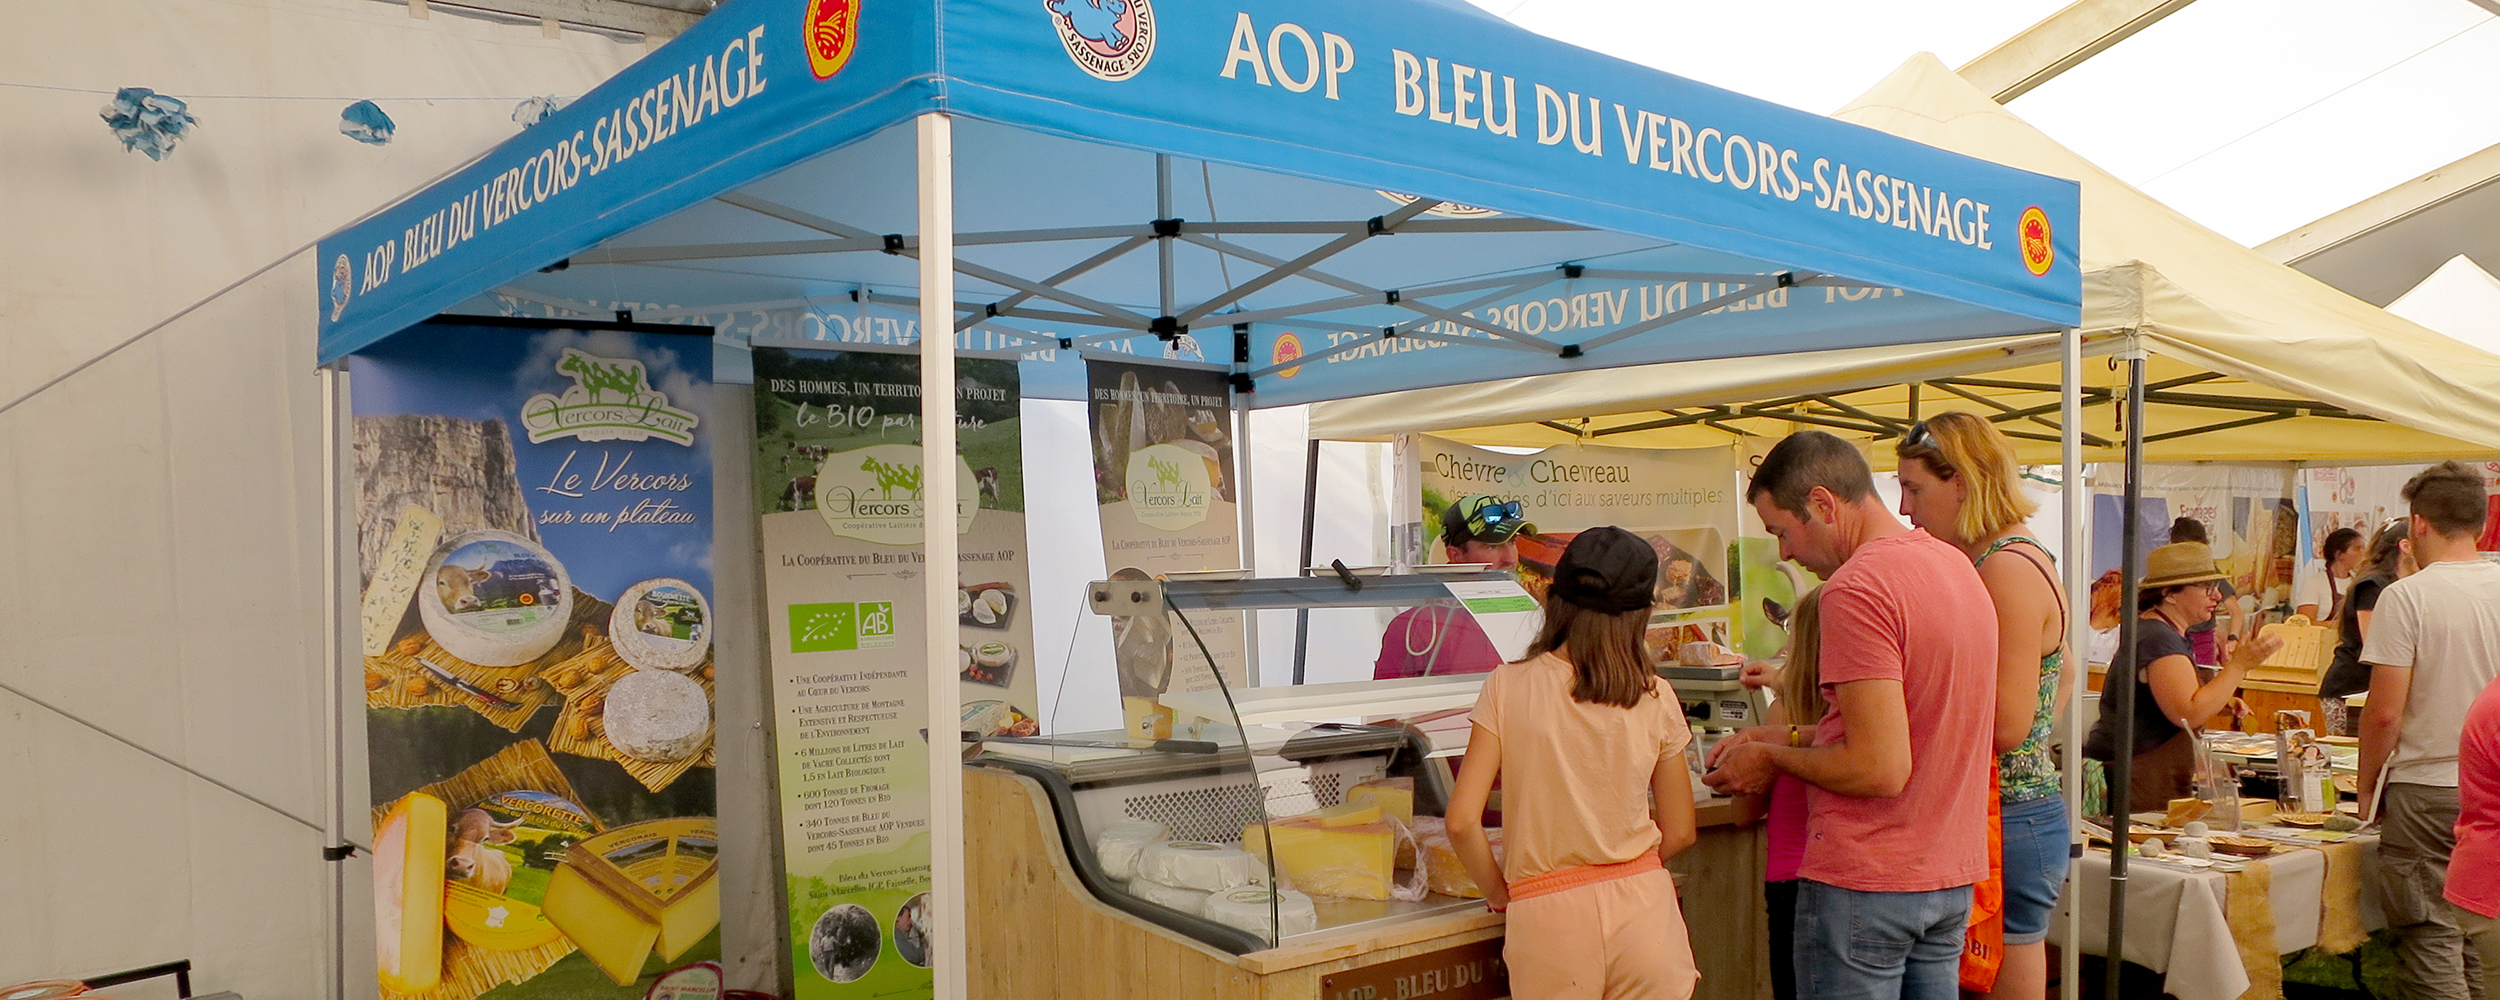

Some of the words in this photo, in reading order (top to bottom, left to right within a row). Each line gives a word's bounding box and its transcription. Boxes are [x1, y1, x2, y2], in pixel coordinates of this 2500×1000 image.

[1127, 12, 1149, 65] VERCORS
[1068, 32, 1126, 73] SASSENAGE
[1220, 12, 1355, 100] AOP
[1392, 48, 1518, 138] BLEU
[1535, 83, 1602, 157] DU
[1614, 103, 1993, 251] VERCORS-SASSENAGE
[359, 238, 395, 296] AOP
[402, 219, 442, 273] BLEU
[447, 195, 475, 255] DU
[482, 24, 768, 231] VERCORS-SASSENAGE
[771, 379, 795, 393] DES
[799, 380, 850, 397] HOMMES,
[854, 381, 870, 395] UN
[966, 387, 1006, 402] PROJET
[1094, 388, 1109, 400] DES
[1140, 391, 1149, 402] UN
[1191, 395, 1200, 406] UN
[1200, 395, 1223, 407] PROJET
[527, 390, 623, 429] Vercors
[624, 393, 684, 433] Lait
[796, 401, 820, 428] le
[826, 404, 875, 429] BIO
[881, 415, 914, 438] par
[536, 450, 583, 498] Le
[590, 450, 693, 492] Vercors
[1435, 452, 1506, 485] Chèvre
[1530, 459, 1631, 484] Chevreau
[826, 485, 910, 518] Vercors
[1132, 479, 1176, 508] Vercors
[1176, 480, 1202, 507] Lait
[1536, 489, 1572, 508] d'ici
[1575, 493, 1597, 507] aux
[1598, 490, 1652, 508] saveurs
[539, 509, 575, 525] sur
[580, 511, 611, 525] un
[609, 498, 697, 533] plateau
[997, 551, 1014, 562] AOP
[861, 612, 889, 635] AB
[800, 748, 807, 757] 6
[803, 789, 821, 799] 600
[823, 799, 839, 809] 120
[501, 796, 585, 827] VERCORETTE
[550, 820, 562, 830] du
[563, 822, 594, 839] Vercor
[805, 819, 823, 829] 340
[878, 821, 894, 832] AOP
[607, 832, 657, 849] VERCORAIS
[826, 841, 837, 850] 45
[839, 874, 857, 883] Bleu
[858, 871, 868, 880] du
[1394, 968, 1449, 1000] BLEU
[1454, 958, 1483, 988] DU
